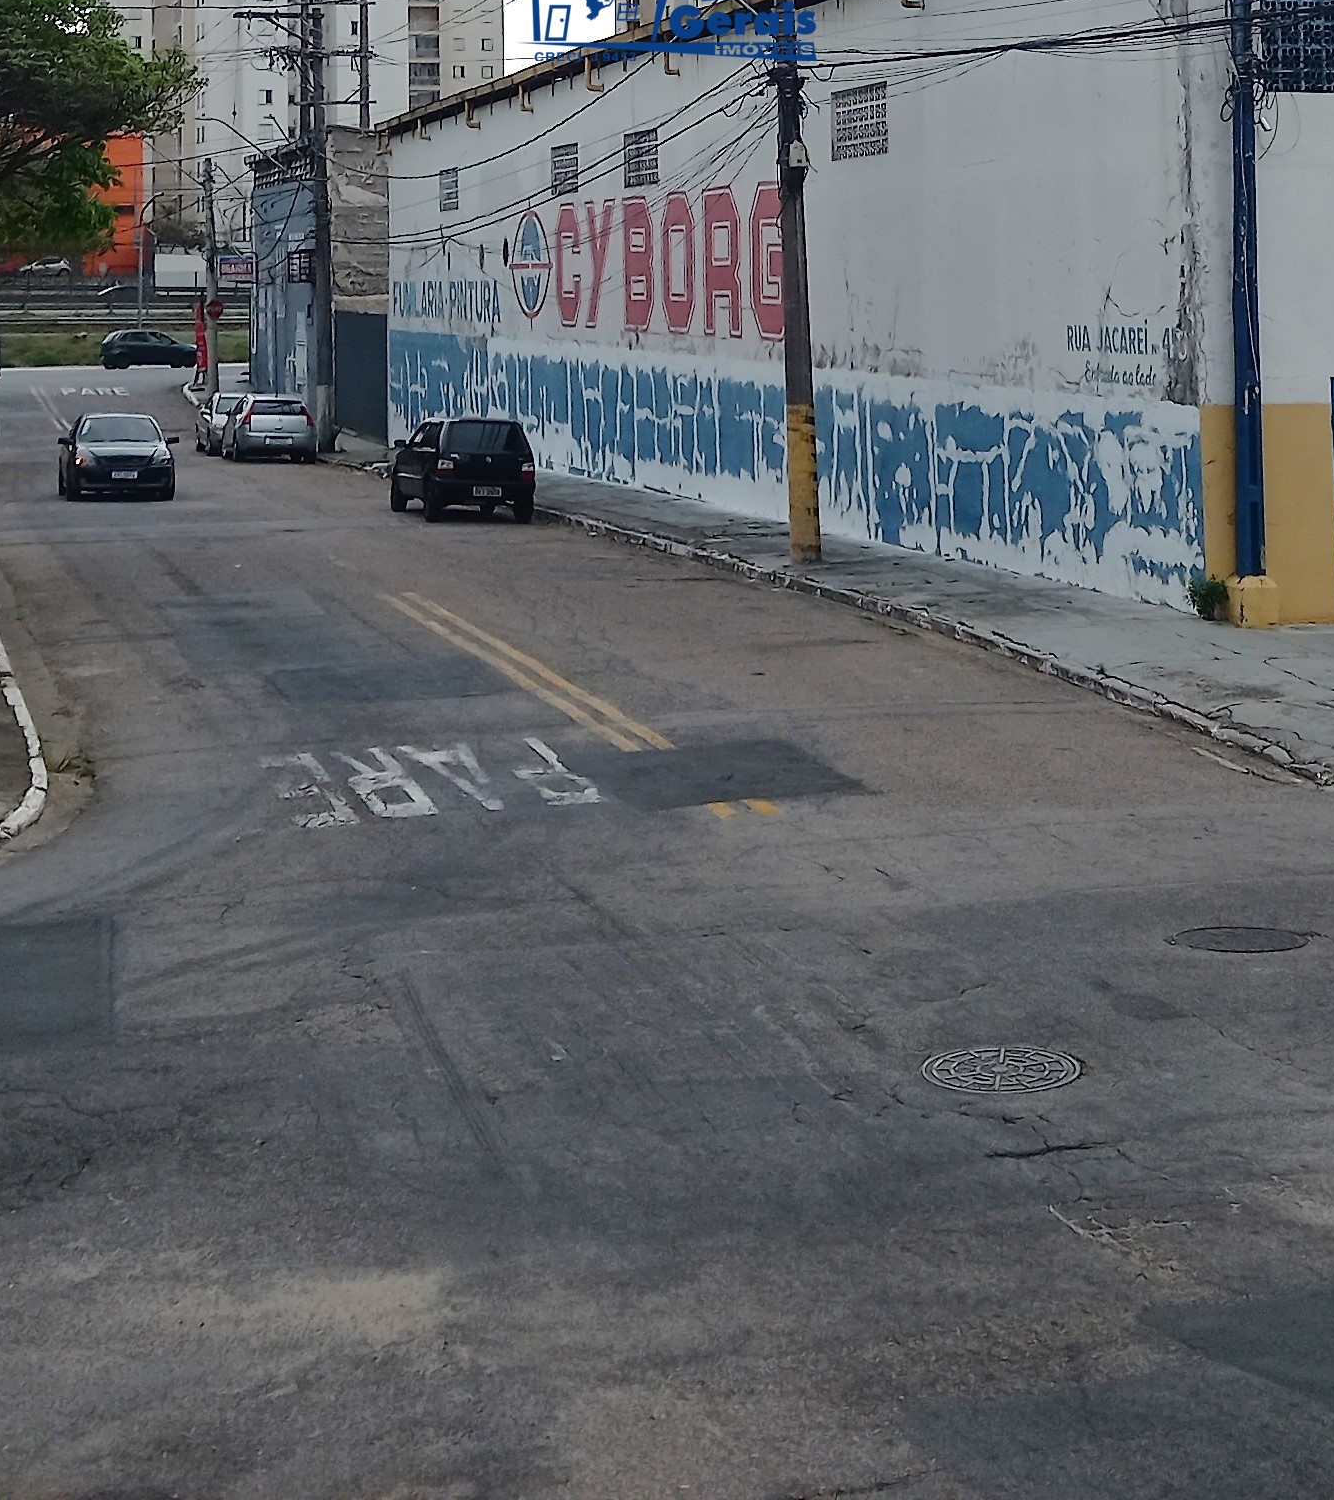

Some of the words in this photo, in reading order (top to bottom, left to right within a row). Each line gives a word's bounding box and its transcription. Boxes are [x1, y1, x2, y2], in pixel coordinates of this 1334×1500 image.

[554, 180, 785, 342] CYBORG
[449, 280, 501, 323] PINTURA
[1067, 325, 1091, 352] RUA
[60, 386, 130, 398] PARE
